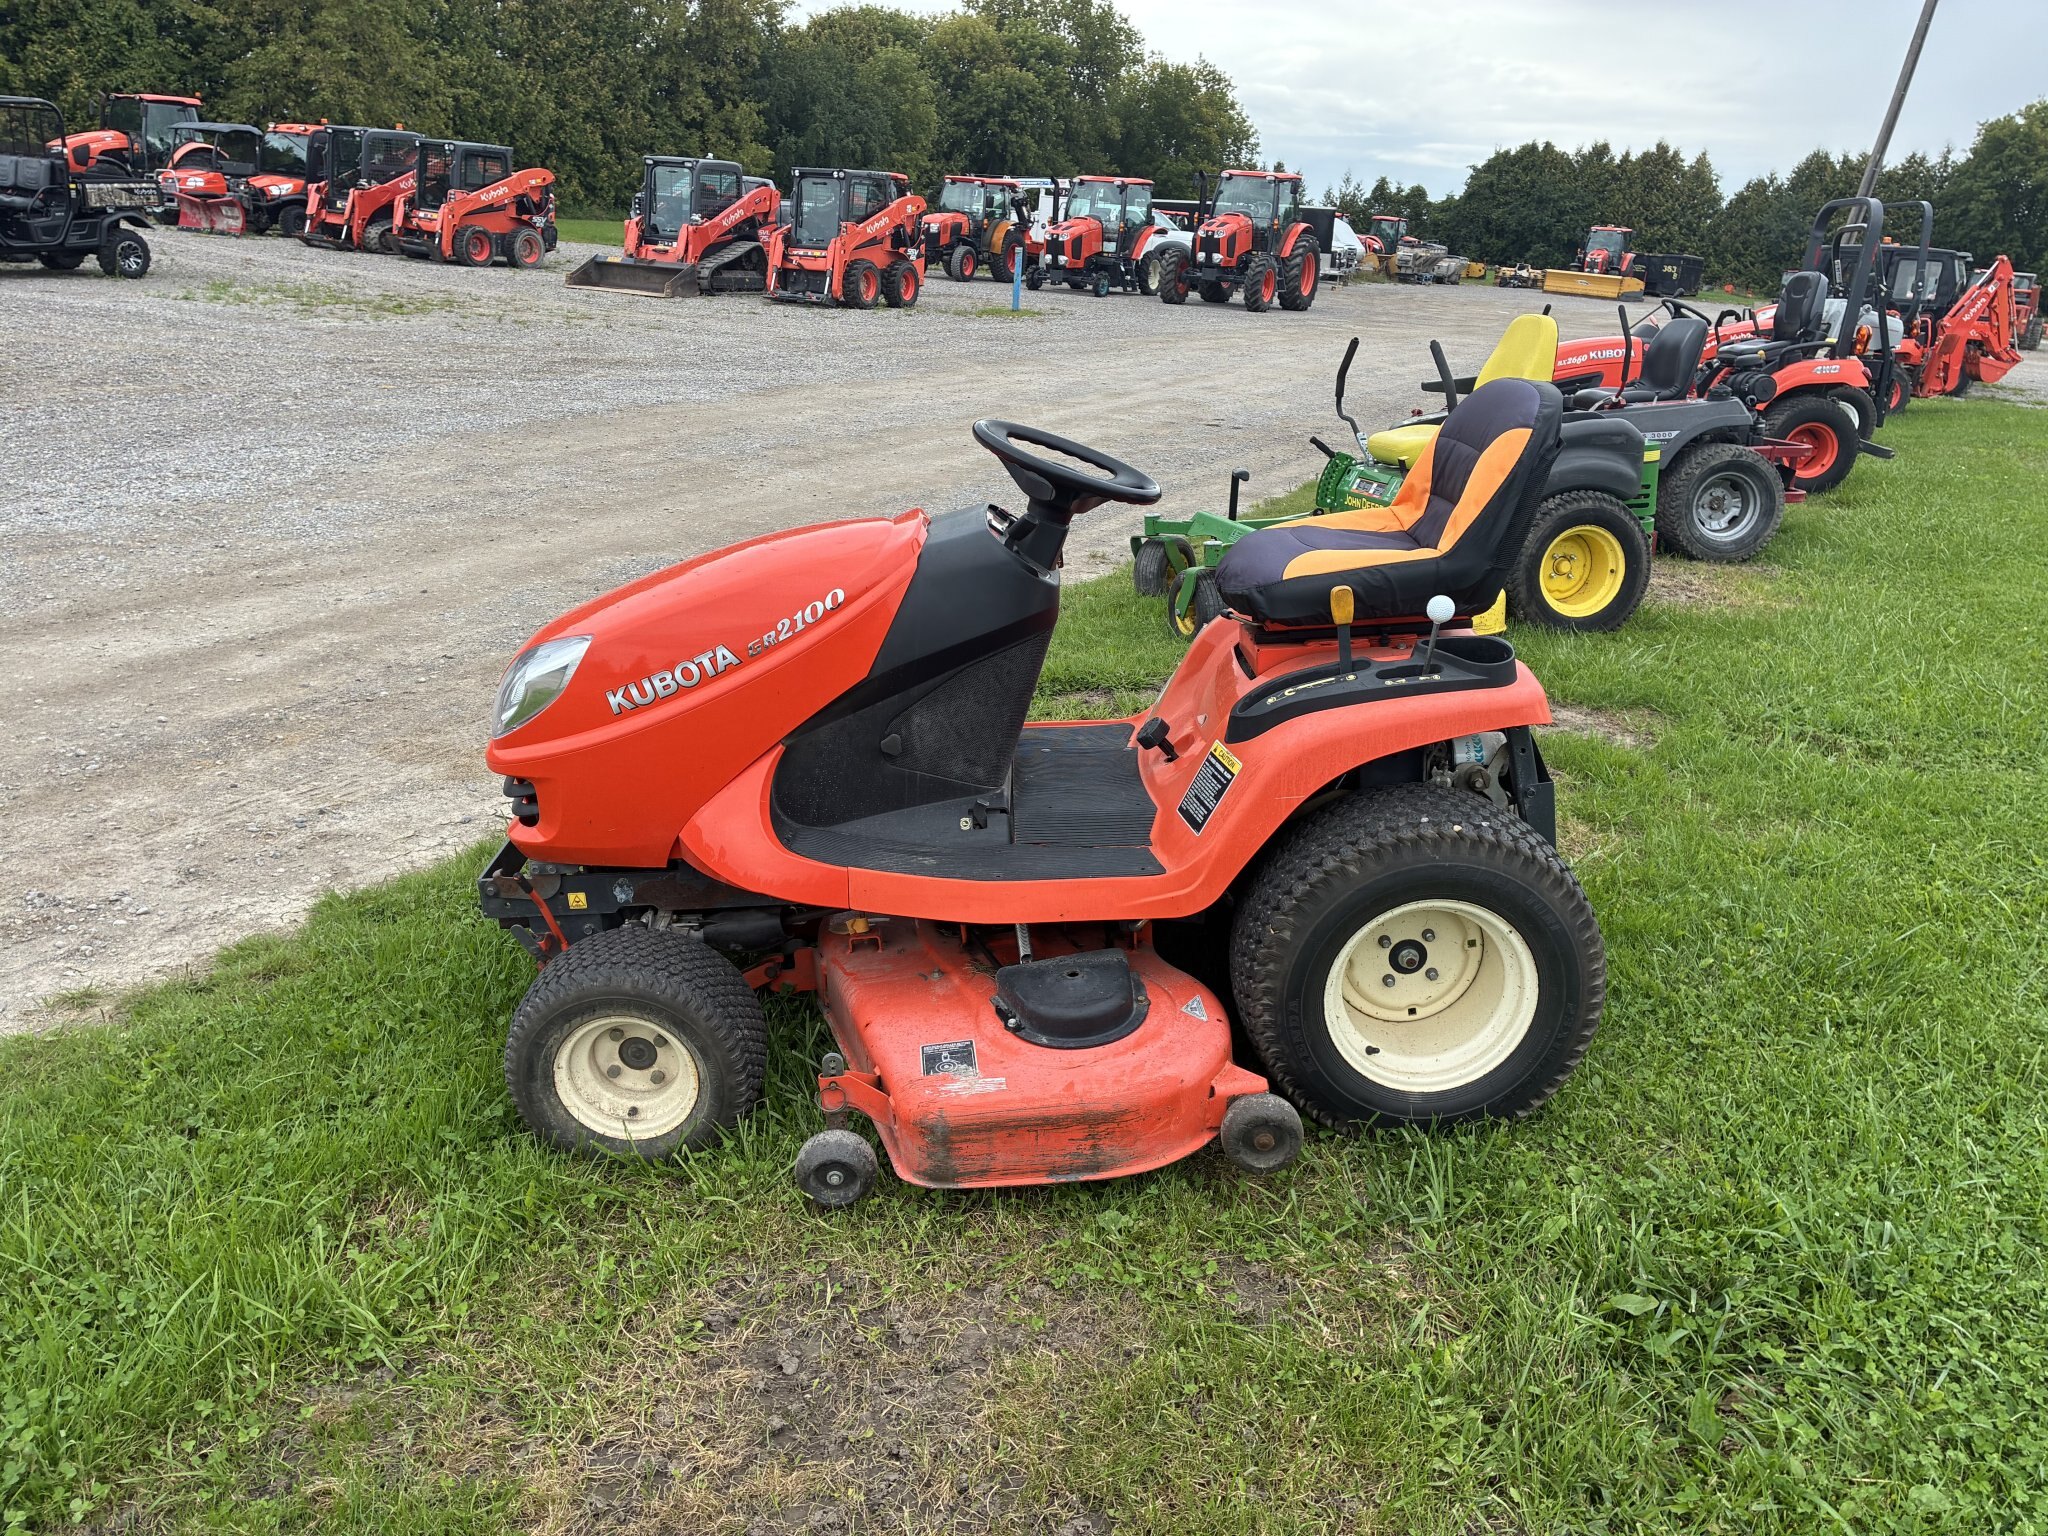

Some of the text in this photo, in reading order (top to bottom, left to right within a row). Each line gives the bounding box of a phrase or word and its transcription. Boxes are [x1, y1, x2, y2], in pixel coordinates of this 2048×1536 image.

[480, 186, 509, 202] Kubota
[722, 208, 744, 226] Kubota
[866, 216, 889, 234] Kubota
[1962, 297, 1987, 322] Kubota
[1812, 364, 1841, 374] 4WD
[1344, 493, 1385, 510] JOHN DEE
[605, 588, 846, 716] KUBOTA GR2100
[1218, 749, 1236, 769] CAUTION
